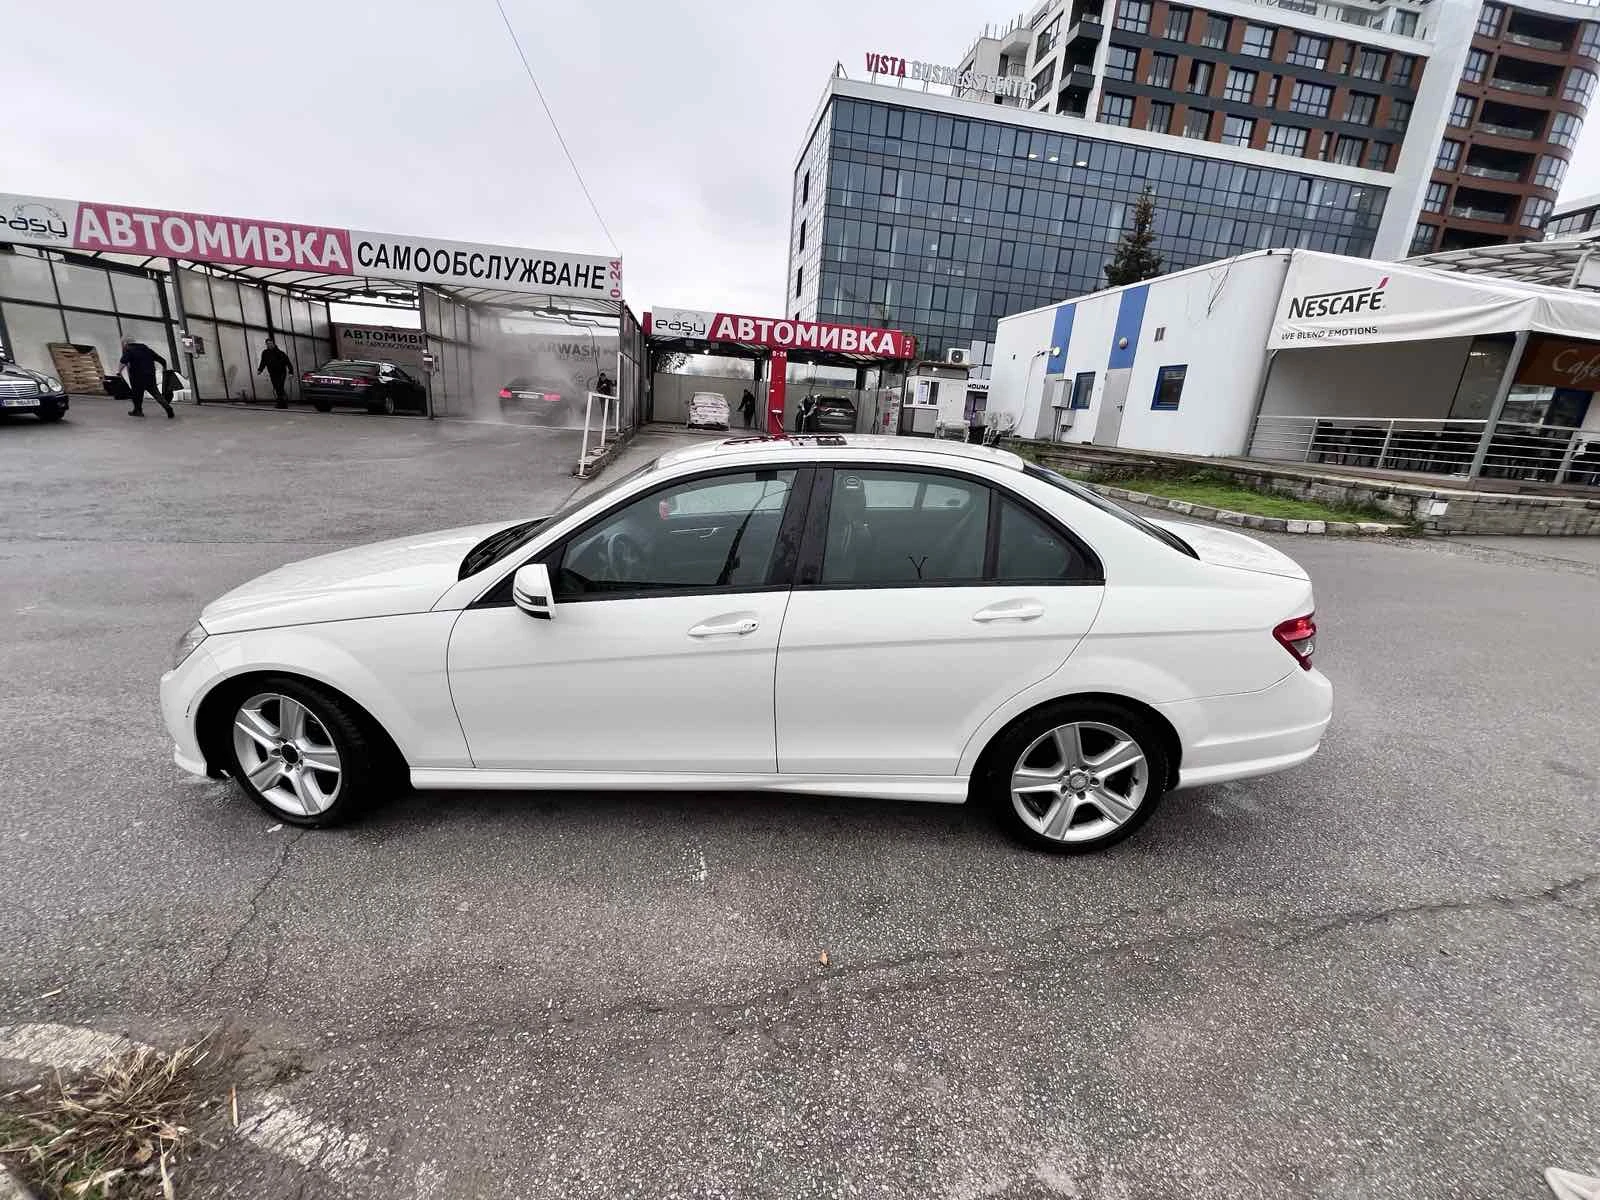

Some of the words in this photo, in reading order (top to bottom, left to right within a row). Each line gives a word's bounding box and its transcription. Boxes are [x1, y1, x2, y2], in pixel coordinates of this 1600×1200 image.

[865, 52, 906, 77] VISTA
[911, 60, 985, 91] BUSINESS
[986, 74, 1037, 100] CENTER
[79, 207, 349, 269] АВТОМИВКА
[357, 241, 607, 290] САМООБСЛУЖВАНЕ
[1288, 277, 1389, 319] NESCAFÉ
[655, 319, 706, 335] easy
[716, 316, 896, 355] АВТОМИВКА
[1281, 332, 1295, 340] WE
[1297, 330, 1326, 340] BLEND
[1328, 326, 1378, 337] EMOTIONS
